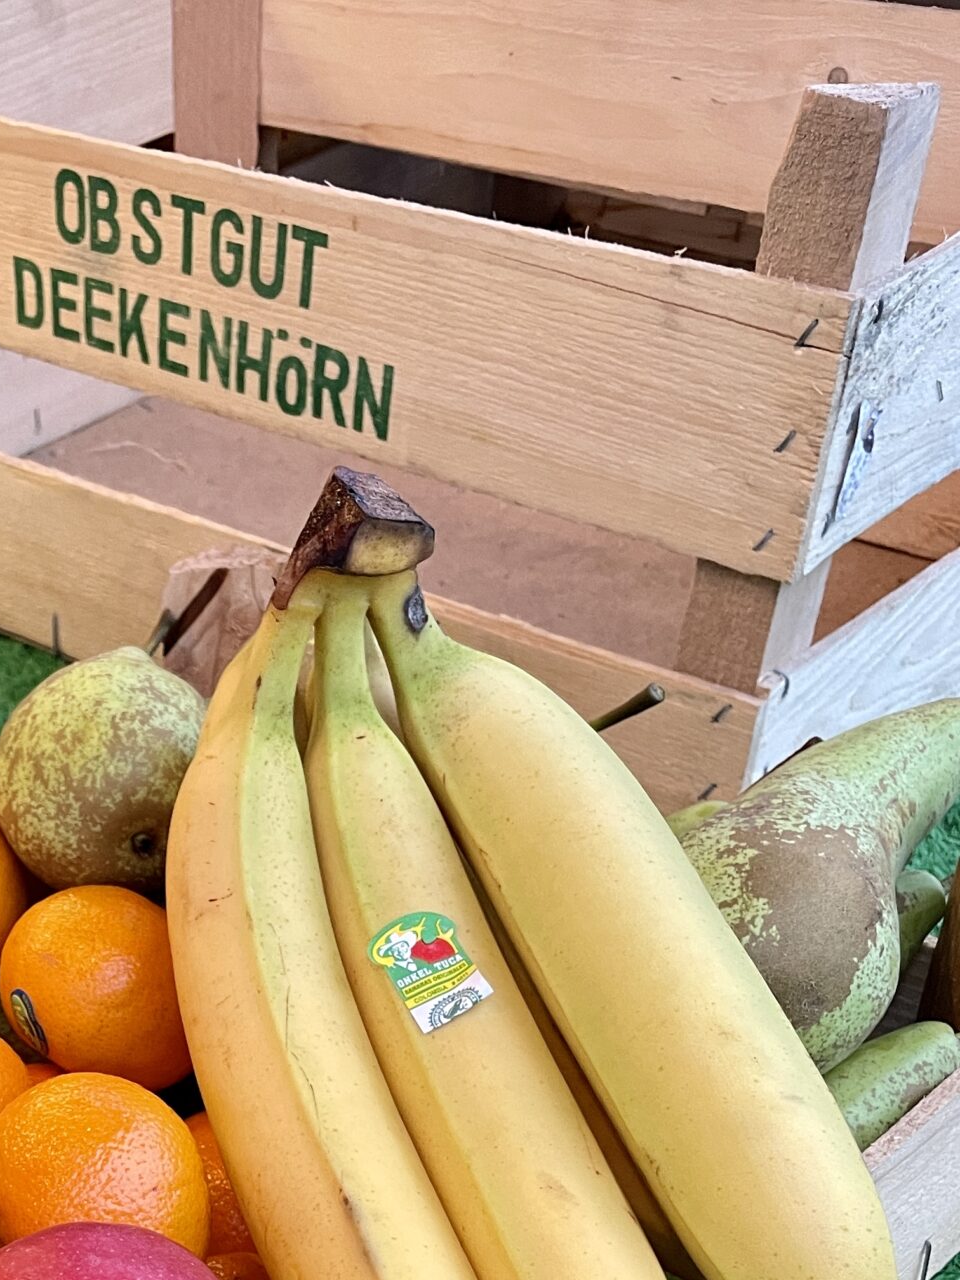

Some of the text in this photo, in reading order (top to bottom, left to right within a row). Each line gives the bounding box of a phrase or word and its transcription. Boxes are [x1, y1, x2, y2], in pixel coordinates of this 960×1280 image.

[54, 168, 329, 310] OBSTGUT
[396, 967, 433, 988] ONKEL
[433, 954, 464, 971] TUCA
